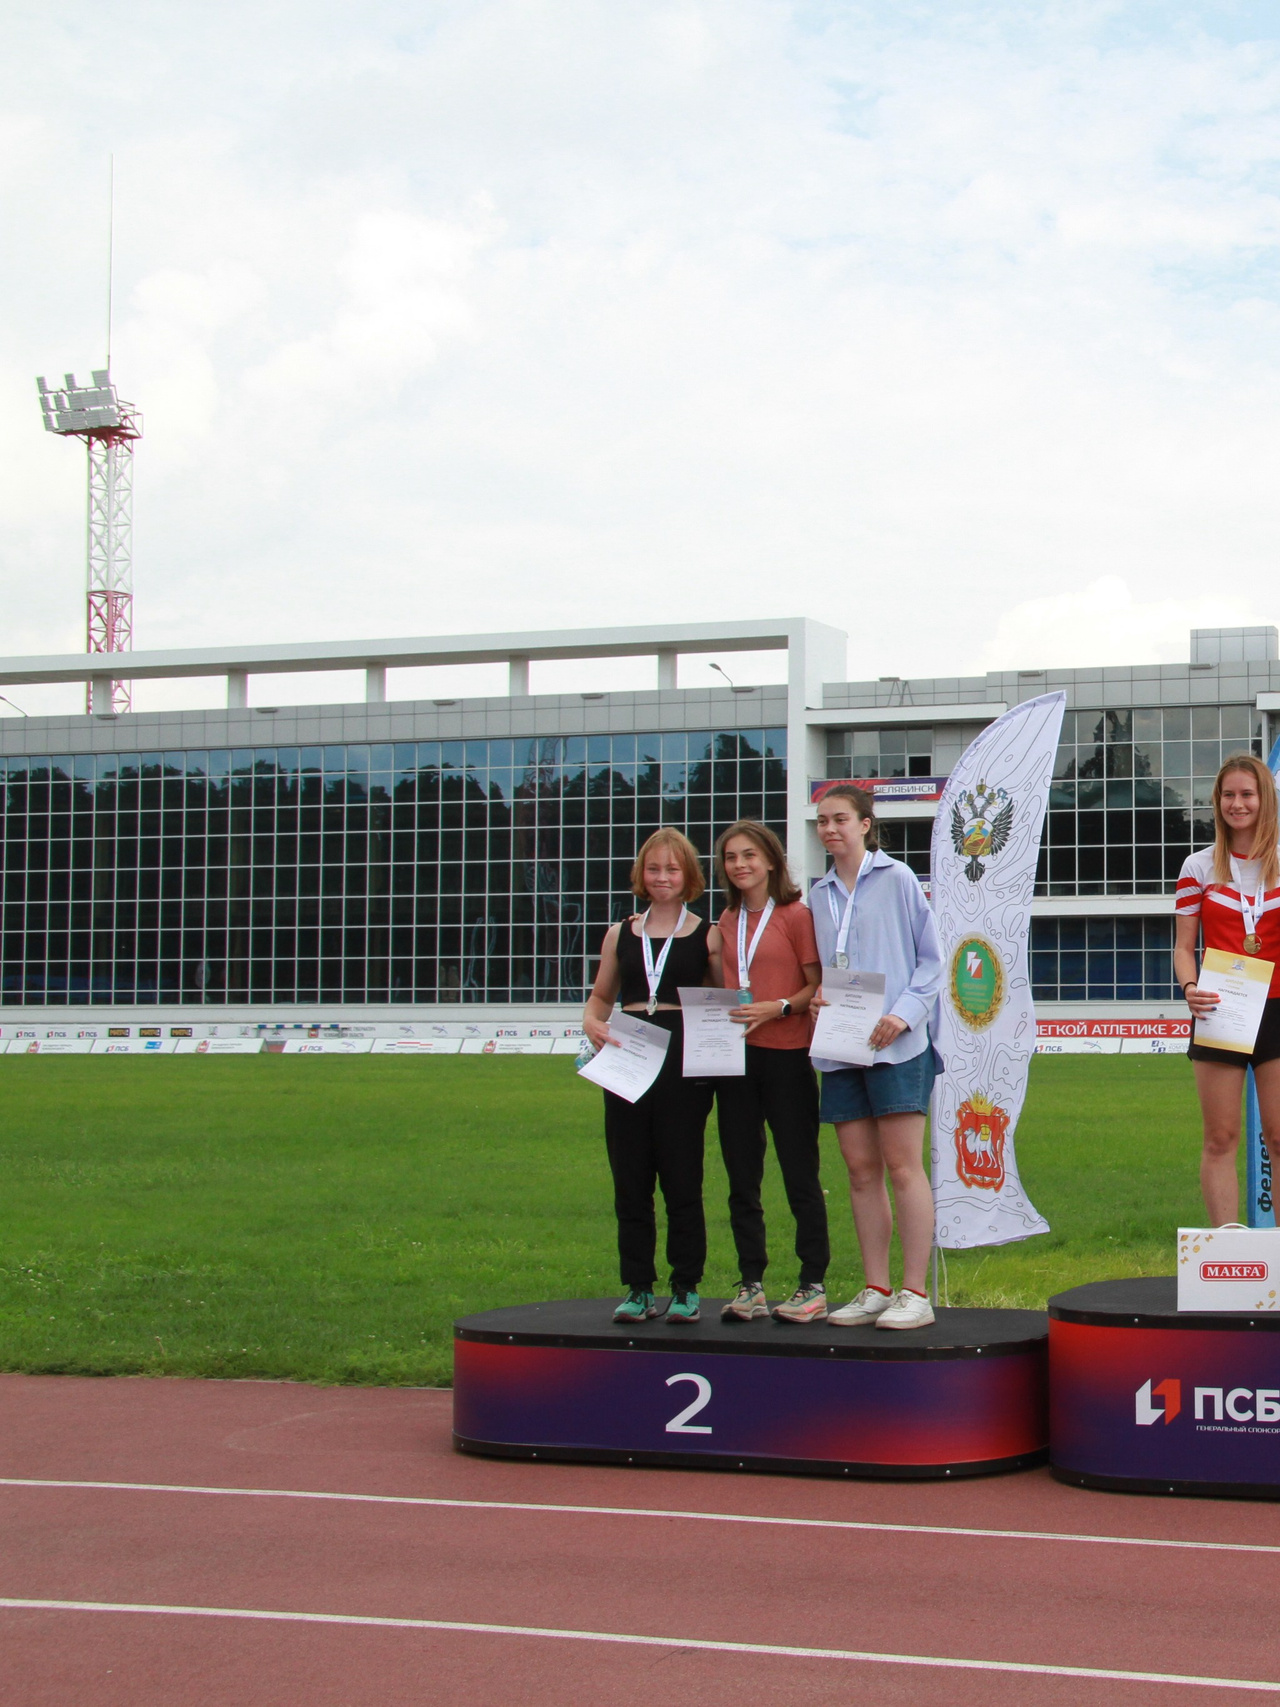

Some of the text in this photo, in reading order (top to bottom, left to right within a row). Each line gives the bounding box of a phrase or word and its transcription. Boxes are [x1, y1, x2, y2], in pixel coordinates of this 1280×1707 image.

[1091, 1024, 1167, 1035] АТЛЕТИКЕ
[1207, 1265, 1261, 1277] MAKFA
[665, 1372, 713, 1434] 2
[1196, 1424, 1246, 1433] ГЕНЕРАЛЬНЫЙ
